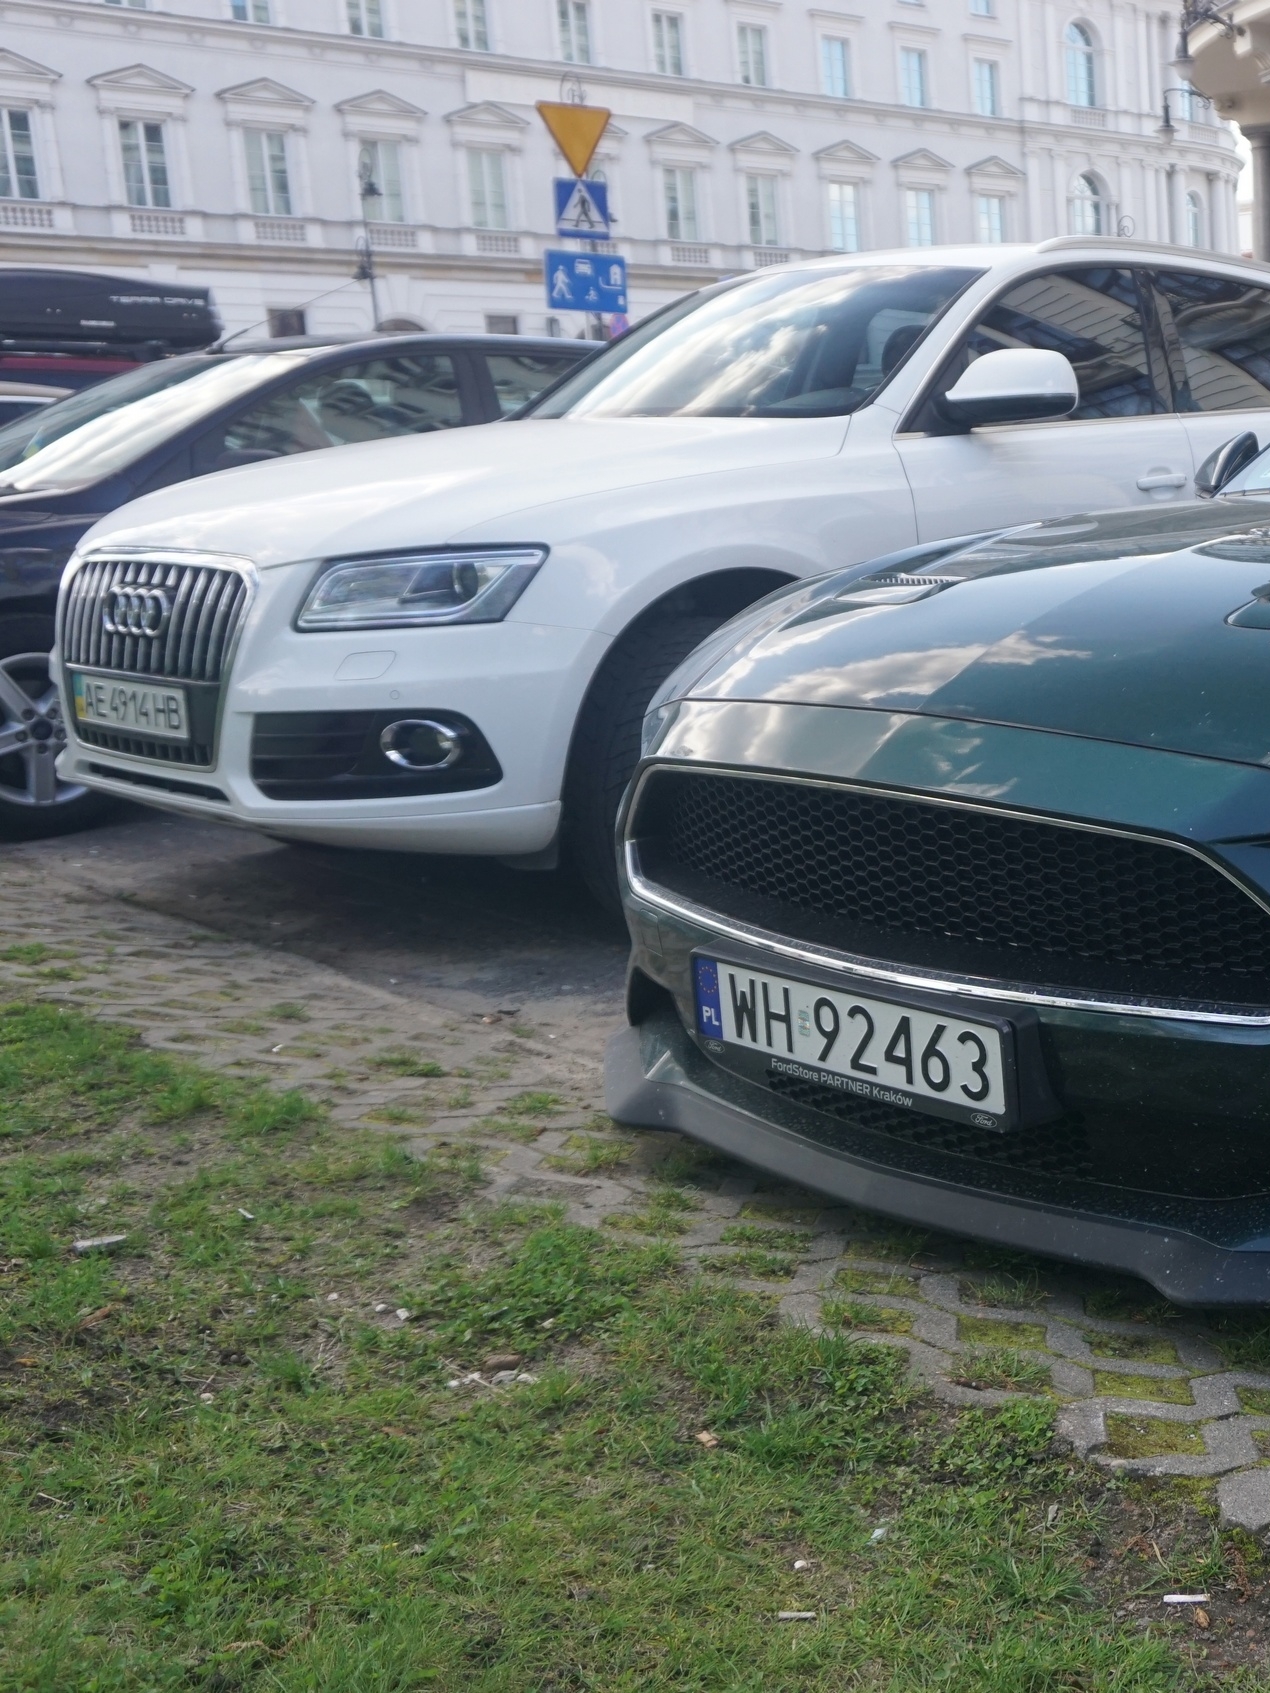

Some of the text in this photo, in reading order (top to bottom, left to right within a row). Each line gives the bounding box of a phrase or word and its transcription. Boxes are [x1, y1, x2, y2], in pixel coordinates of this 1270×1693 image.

[85, 682, 181, 730] AE 4914 HB
[702, 1005, 720, 1026] PL
[728, 972, 989, 1101] WH 92463
[771, 1057, 912, 1107] FordStore PARTNER Kraków
